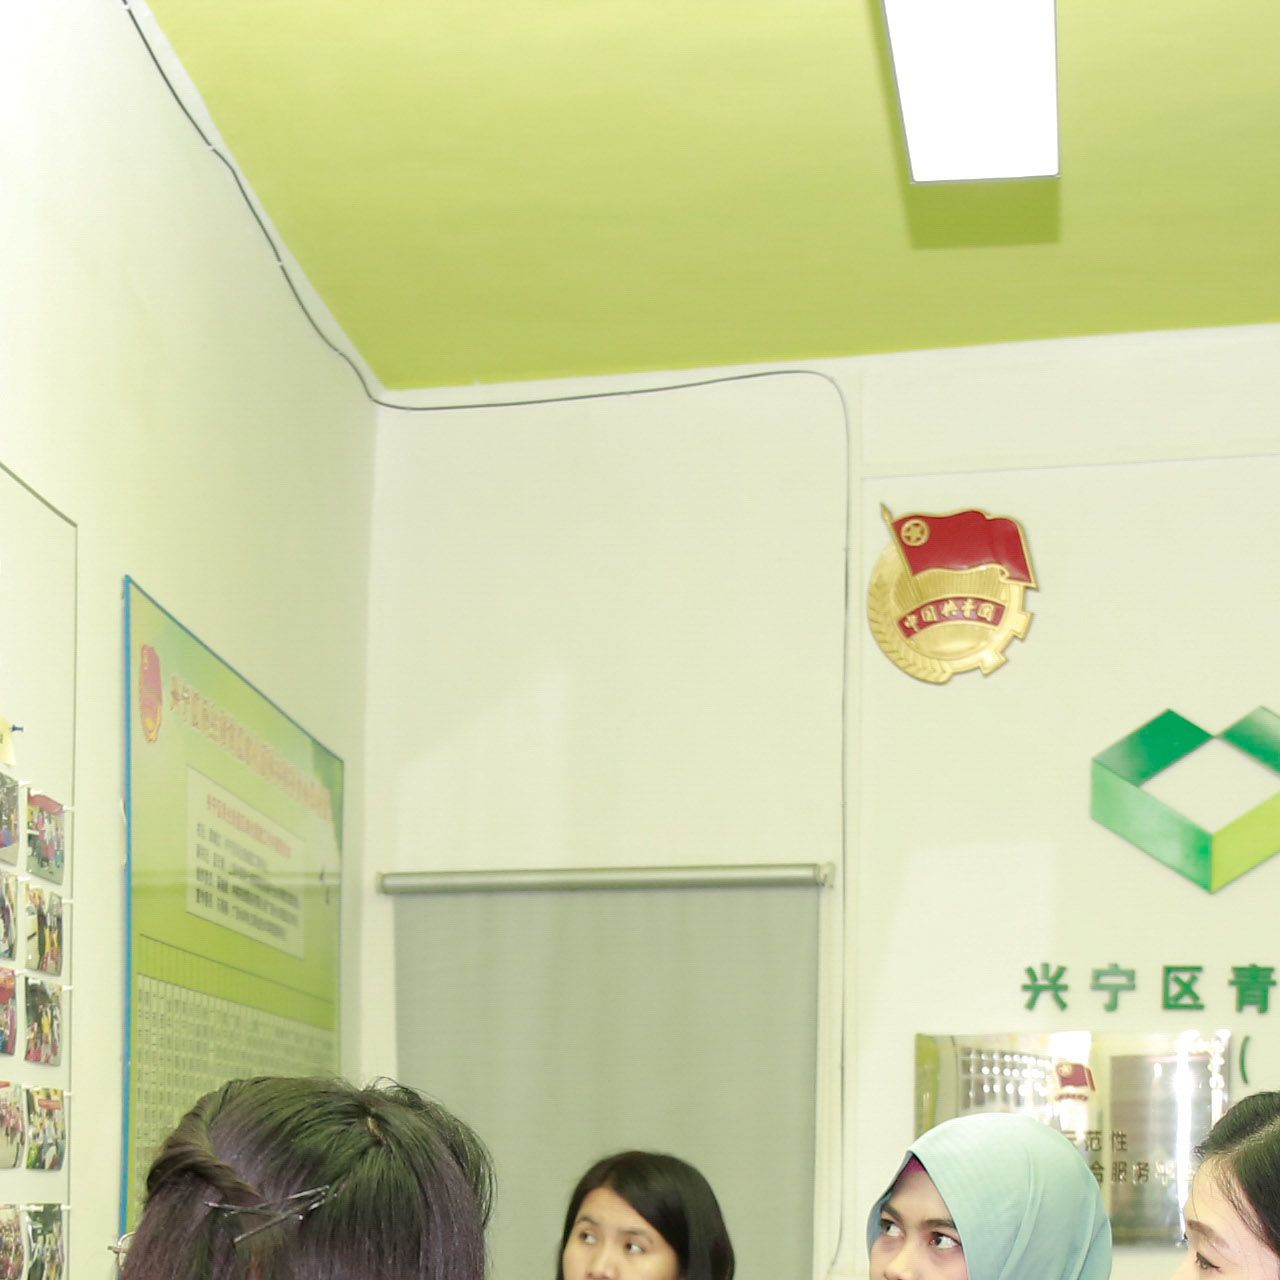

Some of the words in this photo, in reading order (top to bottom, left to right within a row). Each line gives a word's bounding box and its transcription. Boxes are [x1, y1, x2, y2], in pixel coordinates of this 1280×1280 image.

[903, 598, 997, 634] 中国共青团
